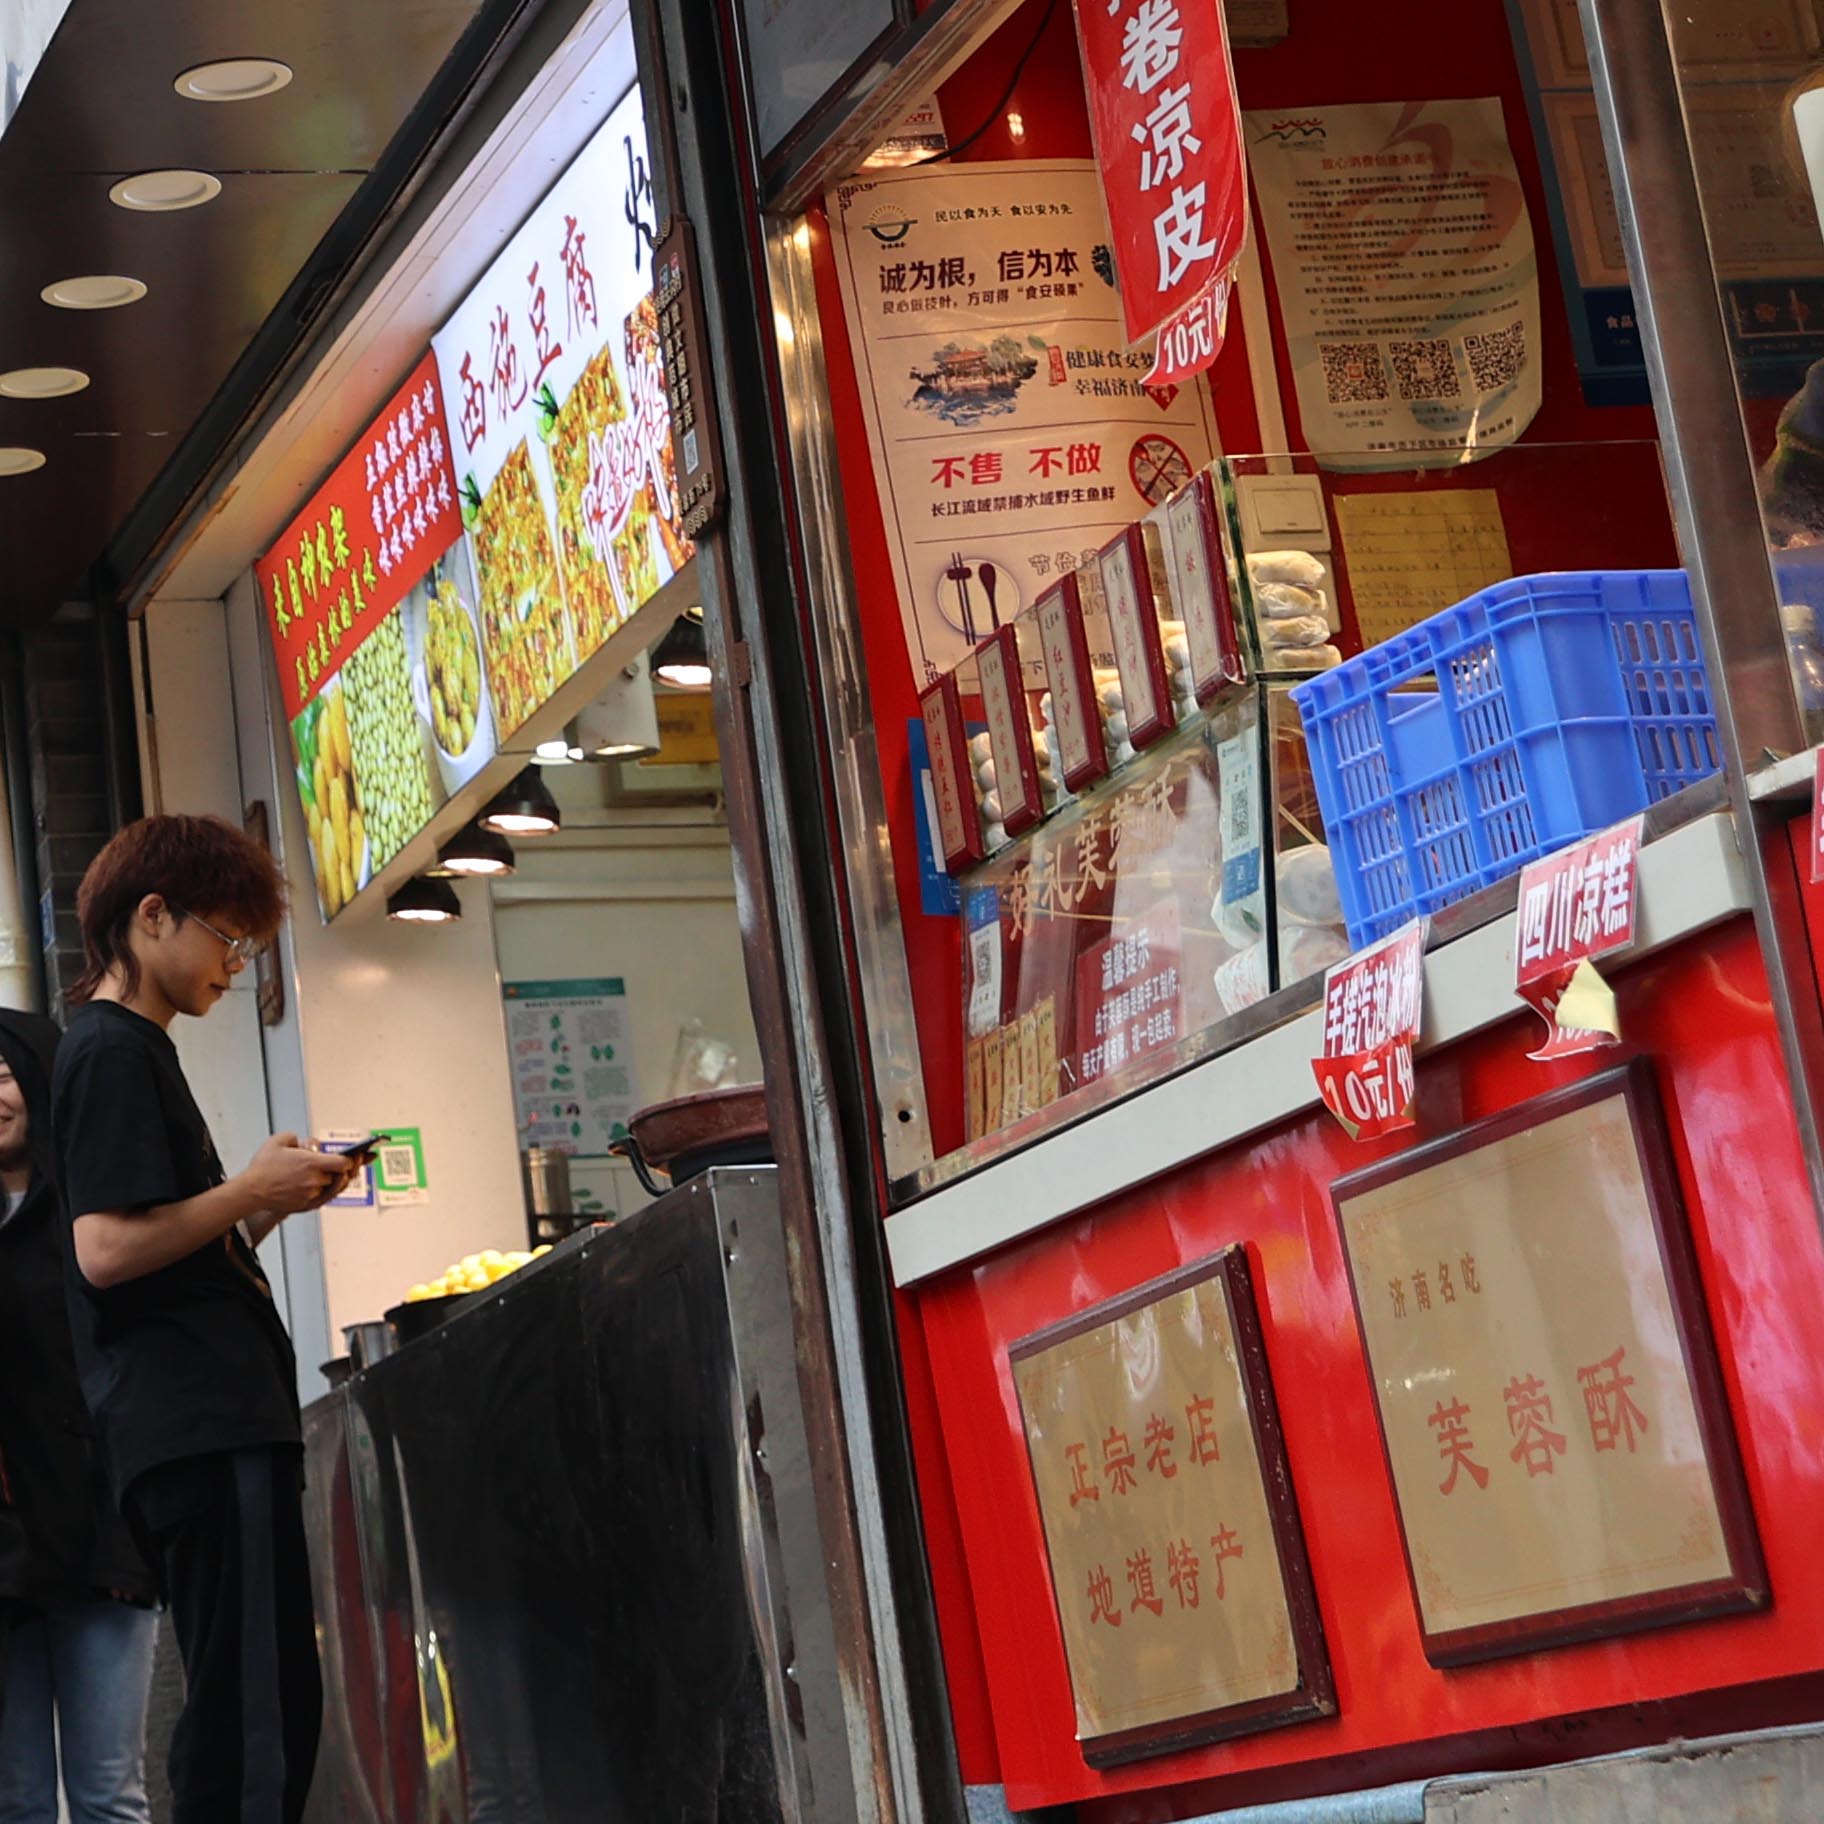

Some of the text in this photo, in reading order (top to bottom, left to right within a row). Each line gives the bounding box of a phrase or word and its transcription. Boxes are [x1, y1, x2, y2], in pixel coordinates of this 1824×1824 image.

[935, 205, 1003, 223] 民以食为天
[1011, 203, 1073, 218] 食以安为先
[458, 215, 600, 455] 西施豆腐
[930, 452, 1004, 490] 不售
[930, 486, 1117, 519] 长江流域禁捕水域野生鱼鲜
[1029, 443, 1103, 479] 不做
[273, 504, 351, 640] 来自神农架
[1521, 838, 1632, 967] 四川凉糕
[1389, 1252, 1483, 1321] 济南名吃
[1064, 1391, 1223, 1511] 正宗老店
[1426, 1346, 1649, 1497] 芙蓉酥
[1086, 1520, 1245, 1630] 地道特产
